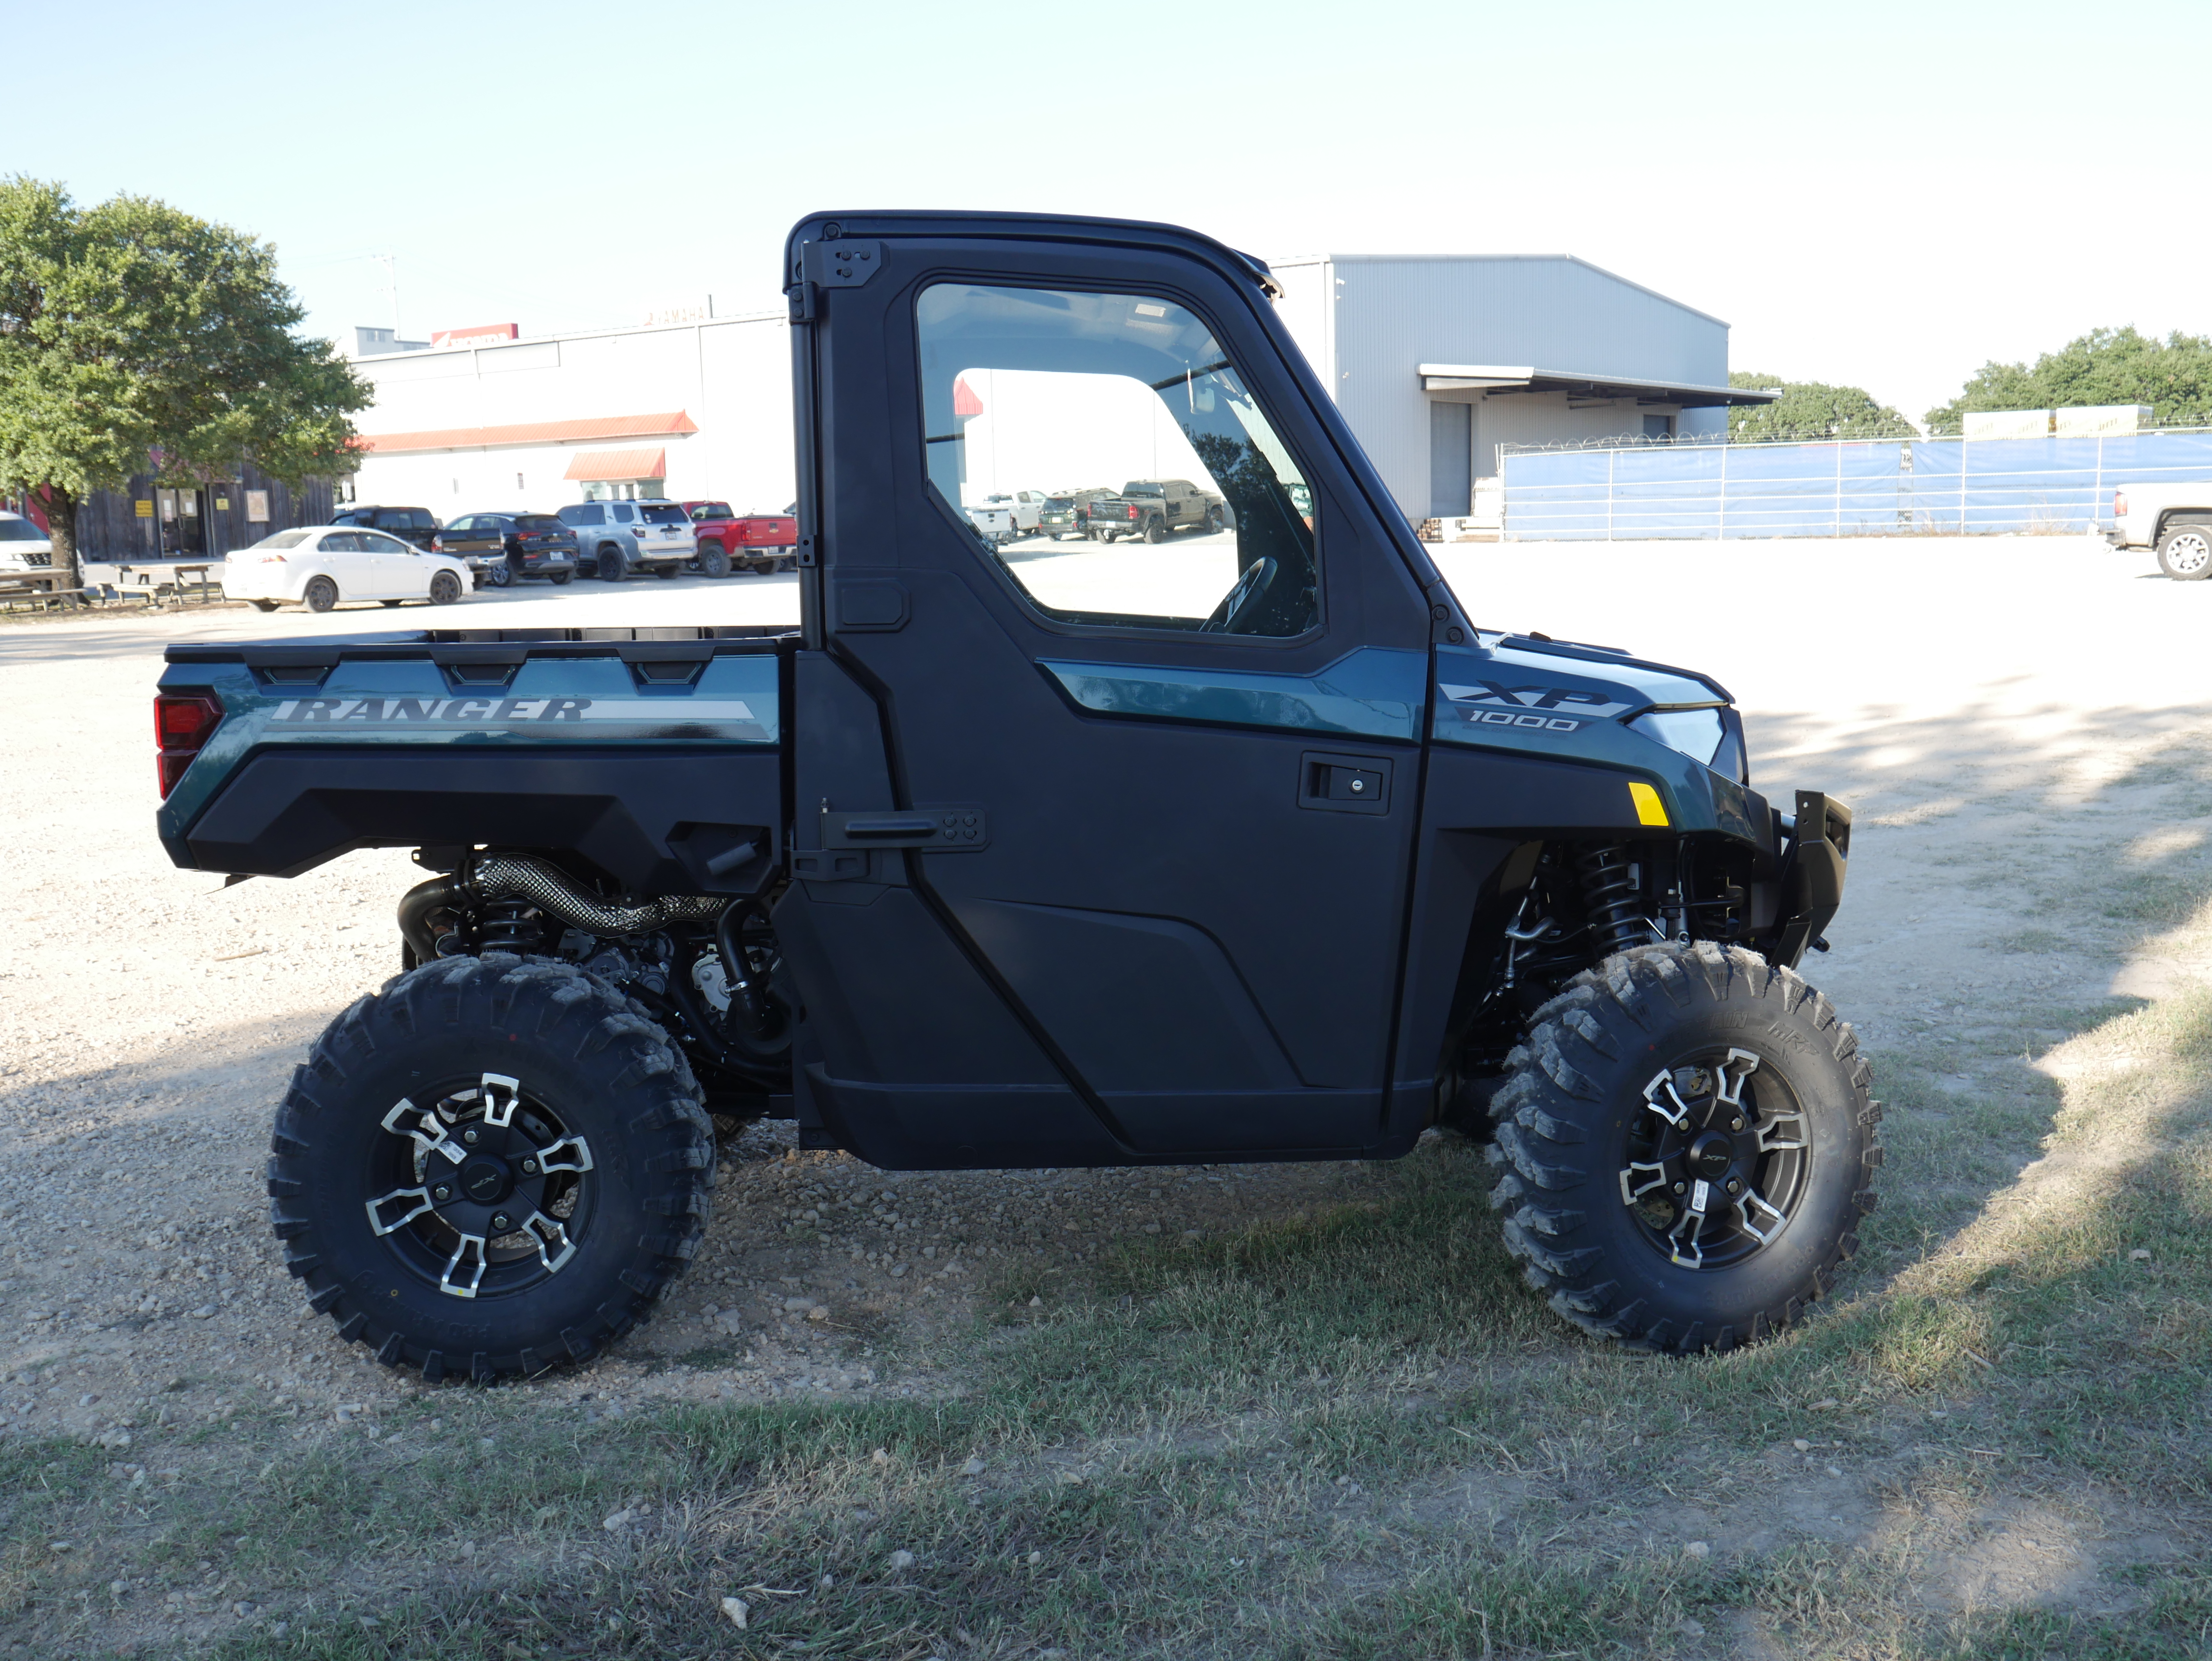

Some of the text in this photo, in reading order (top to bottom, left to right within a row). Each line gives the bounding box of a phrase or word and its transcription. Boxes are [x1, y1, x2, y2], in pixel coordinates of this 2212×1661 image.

[657, 306, 705, 324] YAMAHA
[1454, 680, 1612, 709] XP
[289, 698, 592, 722] RANGER
[1470, 710, 1579, 732] 1000
